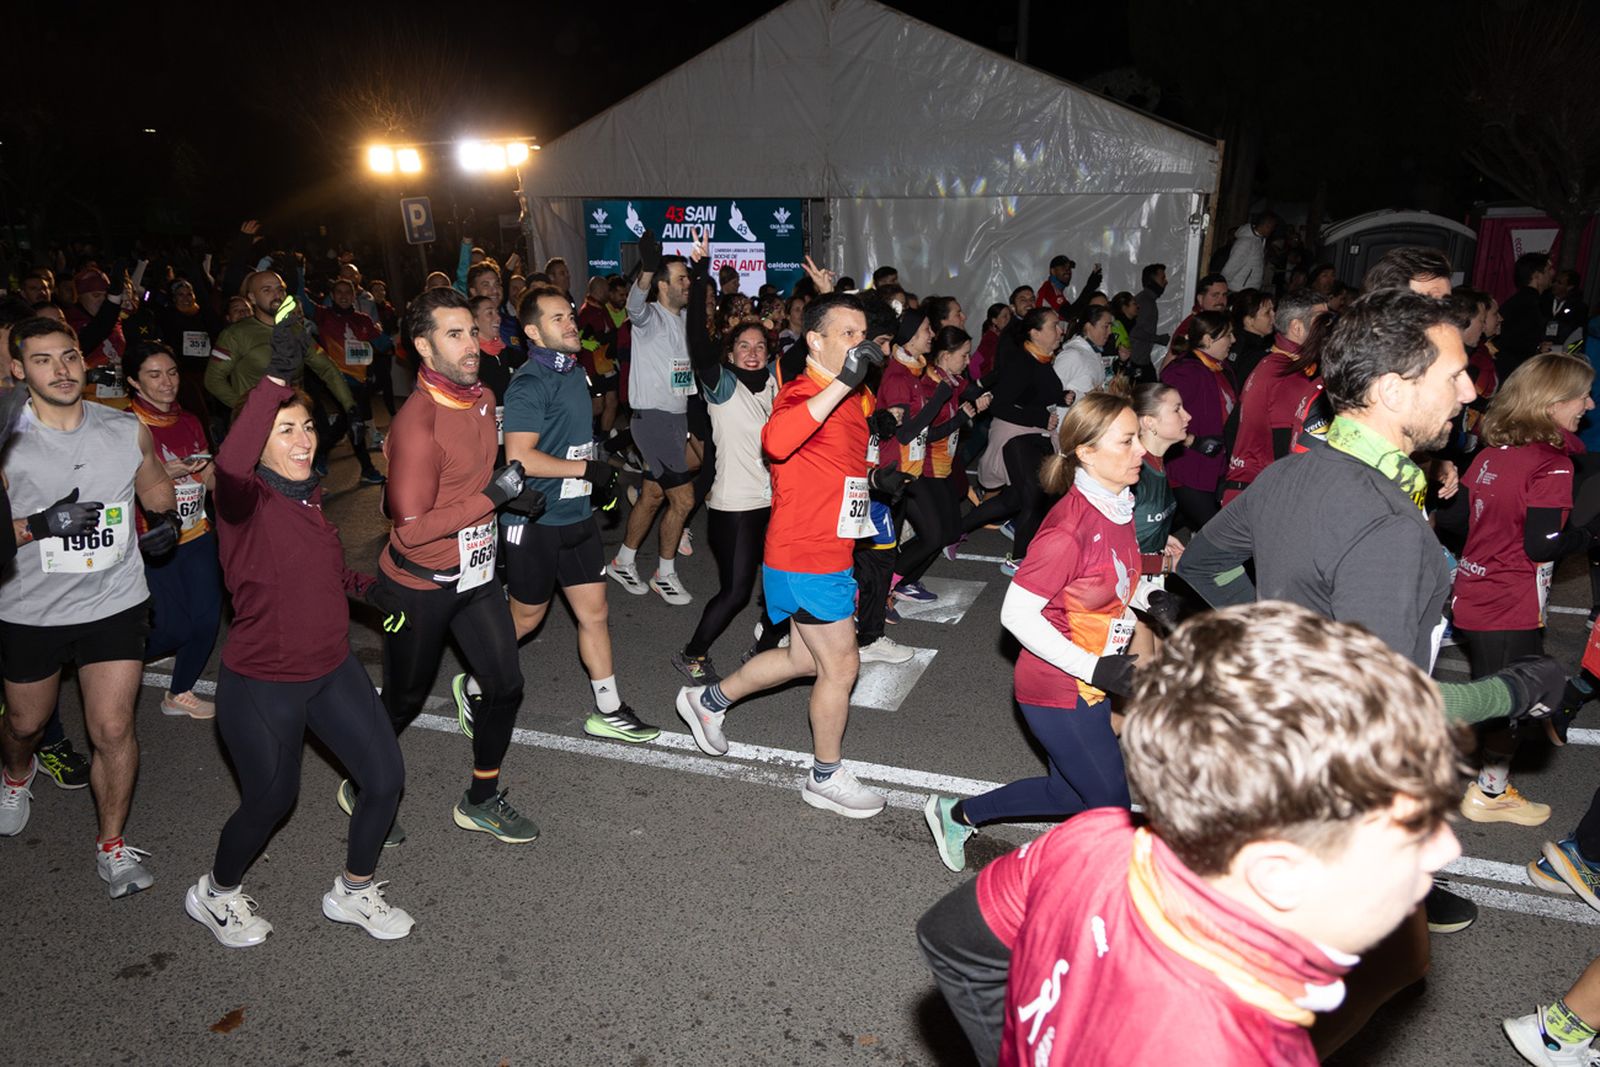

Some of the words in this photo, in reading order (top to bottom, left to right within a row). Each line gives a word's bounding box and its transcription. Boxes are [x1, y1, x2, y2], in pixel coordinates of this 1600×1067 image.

[408, 203, 427, 228] P
[665, 205, 685, 222] 43
[685, 206, 717, 221] SAN
[63, 528, 114, 551] 1966
